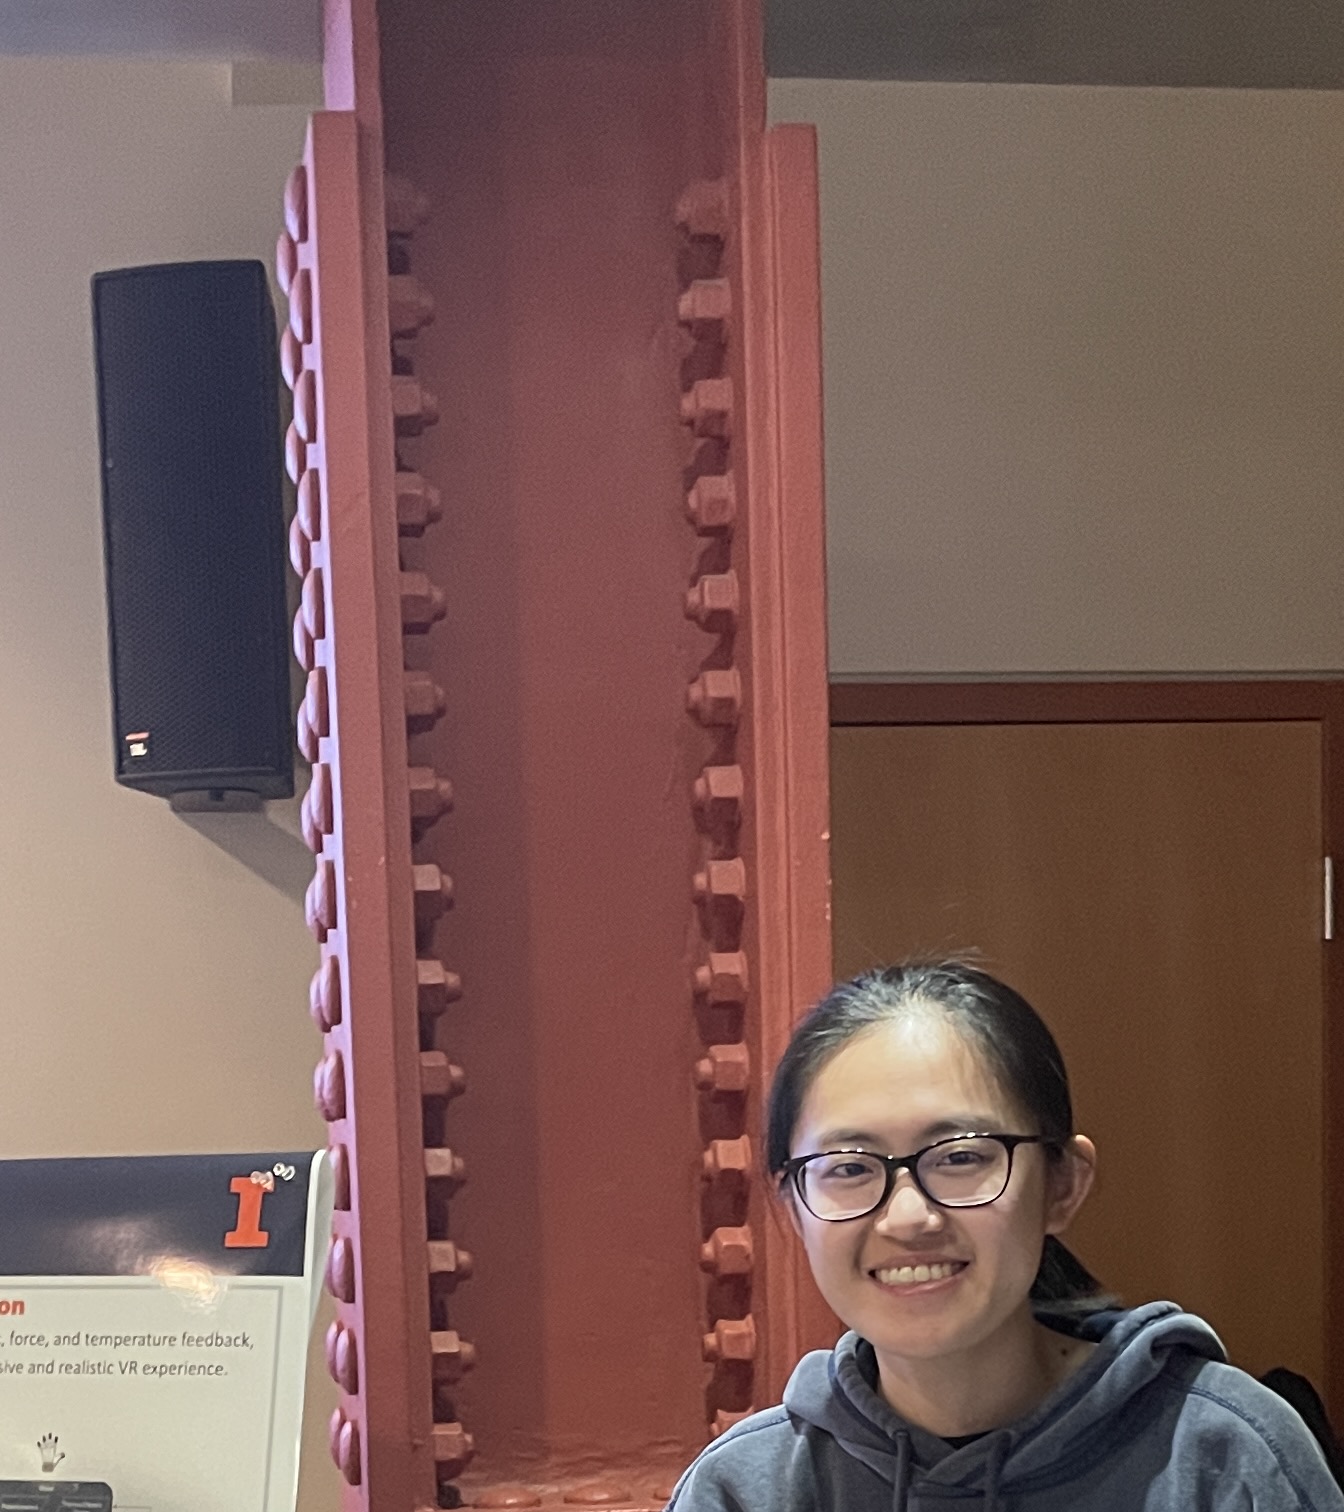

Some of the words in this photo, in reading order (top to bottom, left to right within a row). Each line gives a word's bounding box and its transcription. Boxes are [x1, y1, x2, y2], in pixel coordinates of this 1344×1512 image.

[9, 1331, 50, 1348] force,
[53, 1331, 82, 1346] and
[85, 1333, 177, 1349] temperature
[181, 1331, 254, 1350] feedback,
[27, 1358, 55, 1375] and
[58, 1359, 115, 1375] realistic
[118, 1361, 139, 1375] VR
[142, 1360, 229, 1378] experience.
